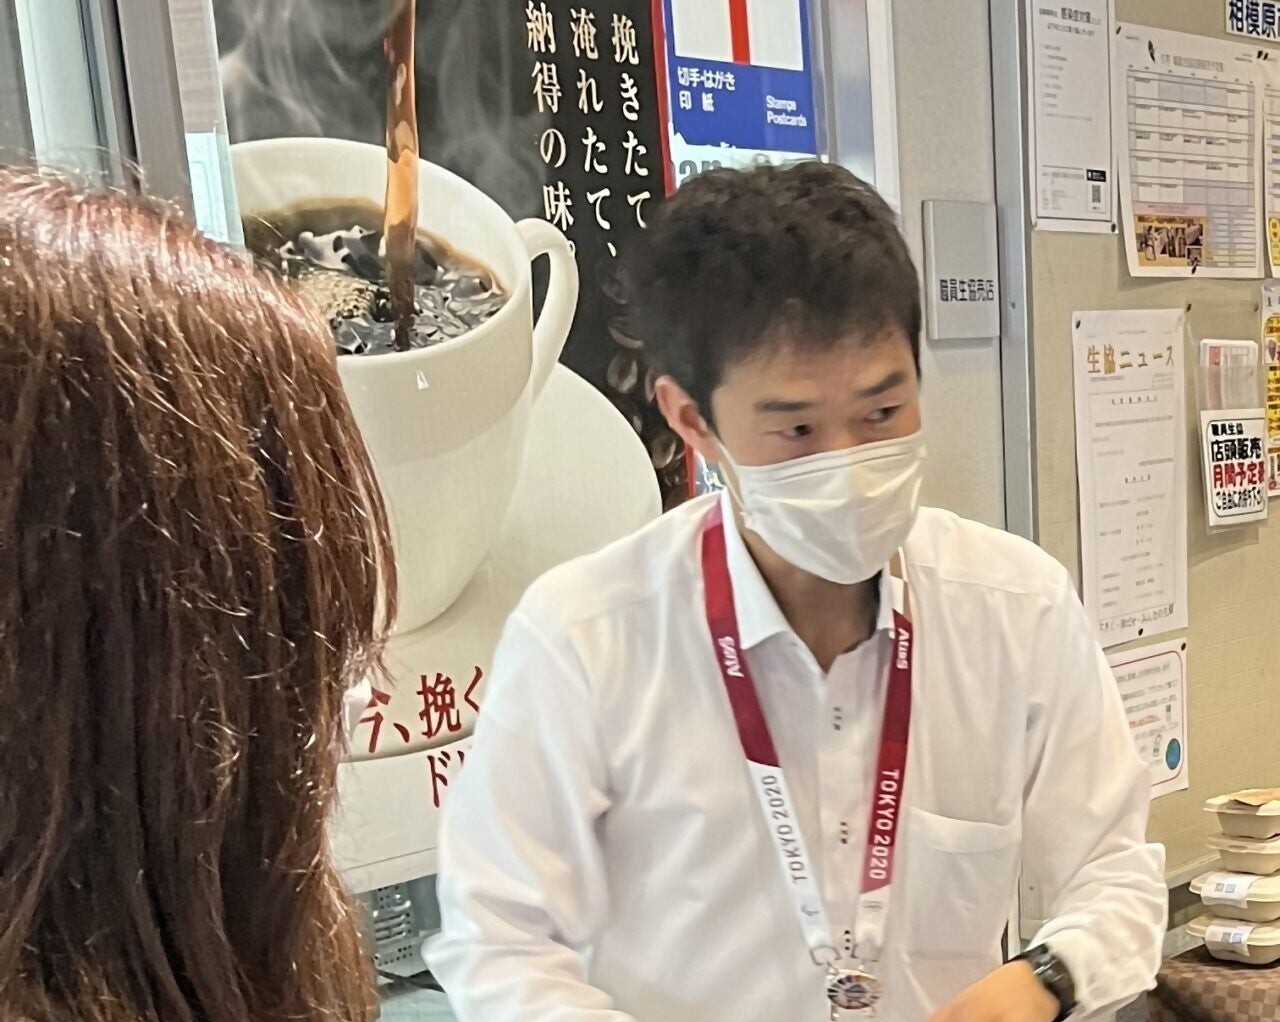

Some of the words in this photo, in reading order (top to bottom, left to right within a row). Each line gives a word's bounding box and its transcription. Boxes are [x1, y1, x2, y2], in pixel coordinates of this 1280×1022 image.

[677, 66, 736, 91] 切手・はがき
[766, 95, 797, 112] Stamps
[525, 1, 576, 257] 納得の味。
[569, 7, 617, 258] 淹れたて、
[610, 13, 651, 229] 挽きたて
[767, 111, 807, 127] Postcards
[1210, 436, 1262, 463] 店頭販売
[359, 665, 484, 754] 今、挽く
[761, 774, 788, 821] 2020
[876, 768, 901, 832] TOKYO
[778, 824, 808, 885] TOKYO
[869, 835, 892, 881] 2020
